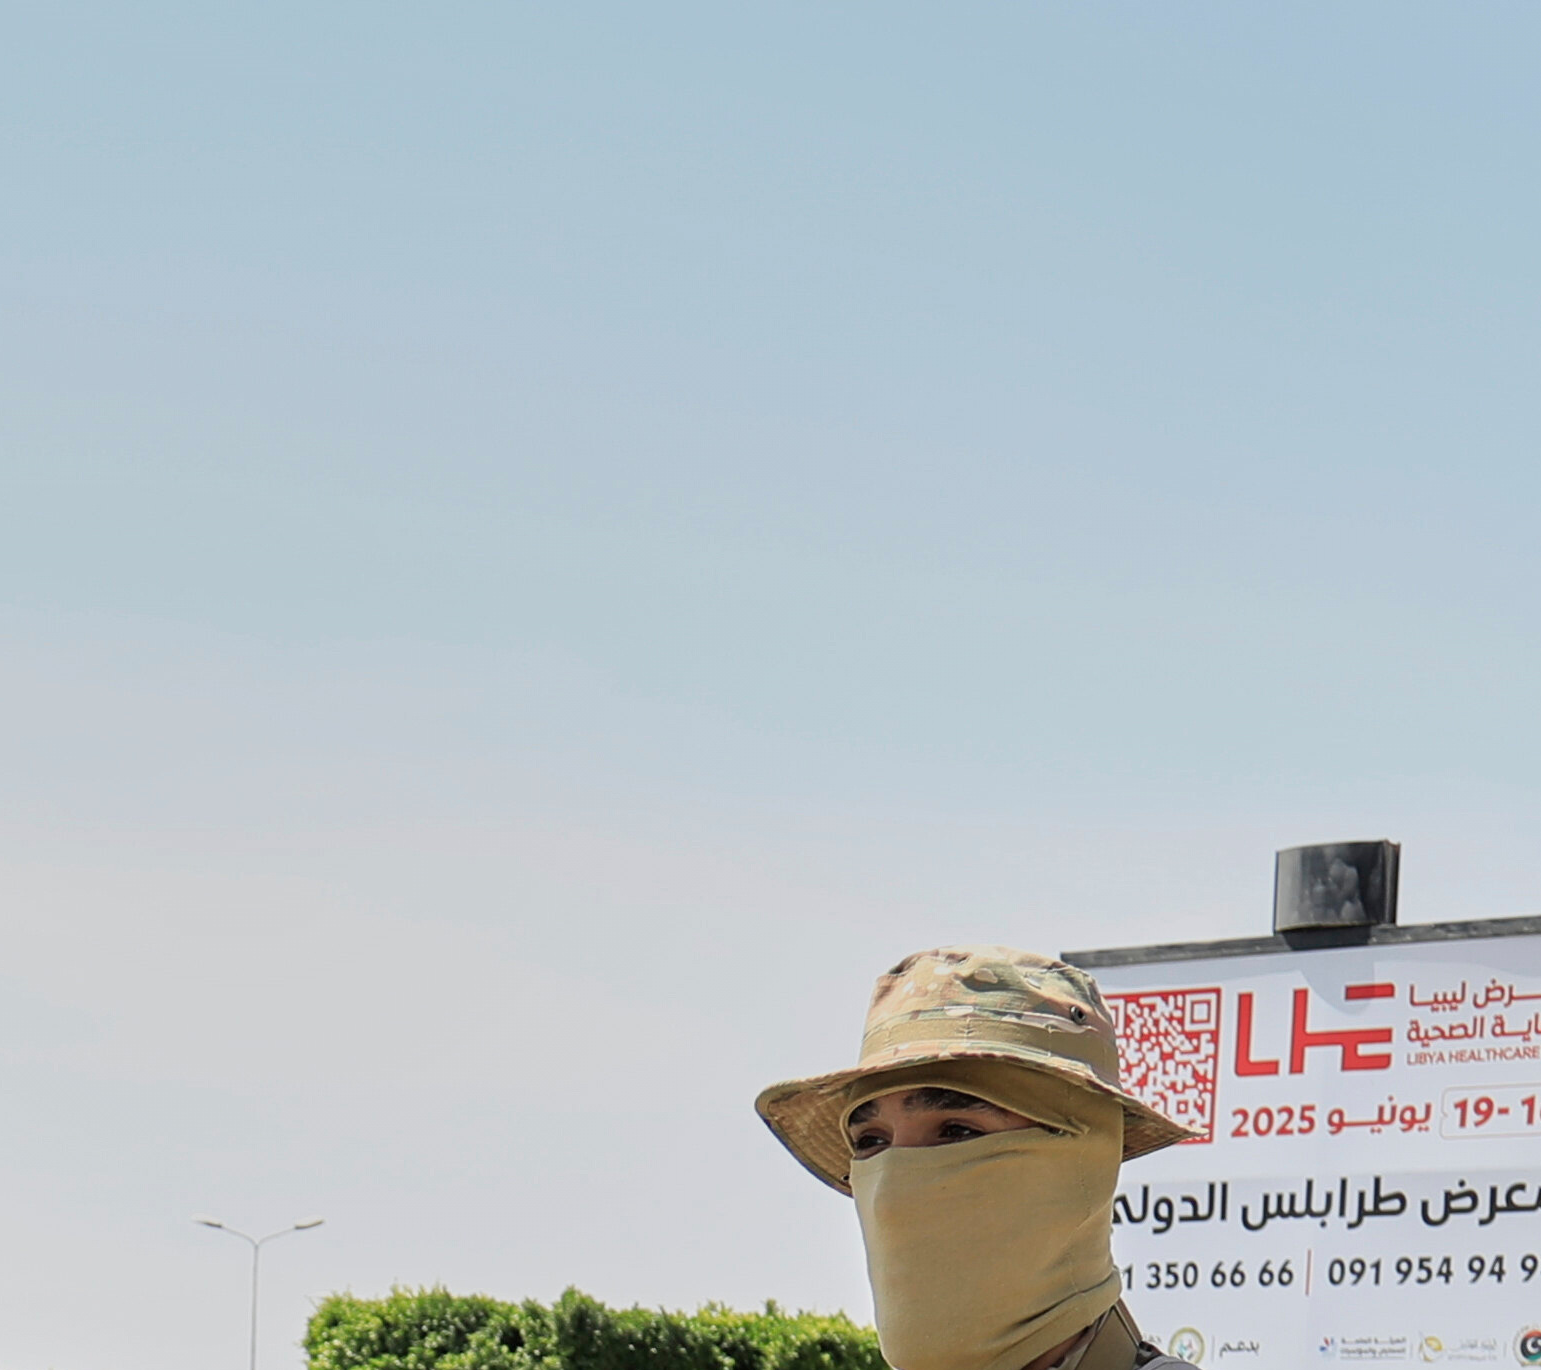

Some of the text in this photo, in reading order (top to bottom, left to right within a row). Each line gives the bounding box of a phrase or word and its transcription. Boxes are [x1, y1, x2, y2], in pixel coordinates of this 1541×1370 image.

[1409, 981, 1466, 1013] ليبيا
[1406, 1016, 1486, 1048] الصحية
[1406, 1049, 1447, 1066] LIBYA
[1448, 1046, 1541, 1062] HEALTHCARE
[1230, 1104, 1316, 1139] 2025
[1326, 1096, 1432, 1136] يونيو
[1240, 1176, 1409, 1233] طرابلس
[1145, 1261, 1199, 1290] 350
[1210, 1260, 1247, 1289] 66
[1257, 1258, 1295, 1287] 66
[1327, 1256, 1383, 1287] 091
[1395, 1255, 1454, 1285] 954
[1467, 1254, 1507, 1284] 94
